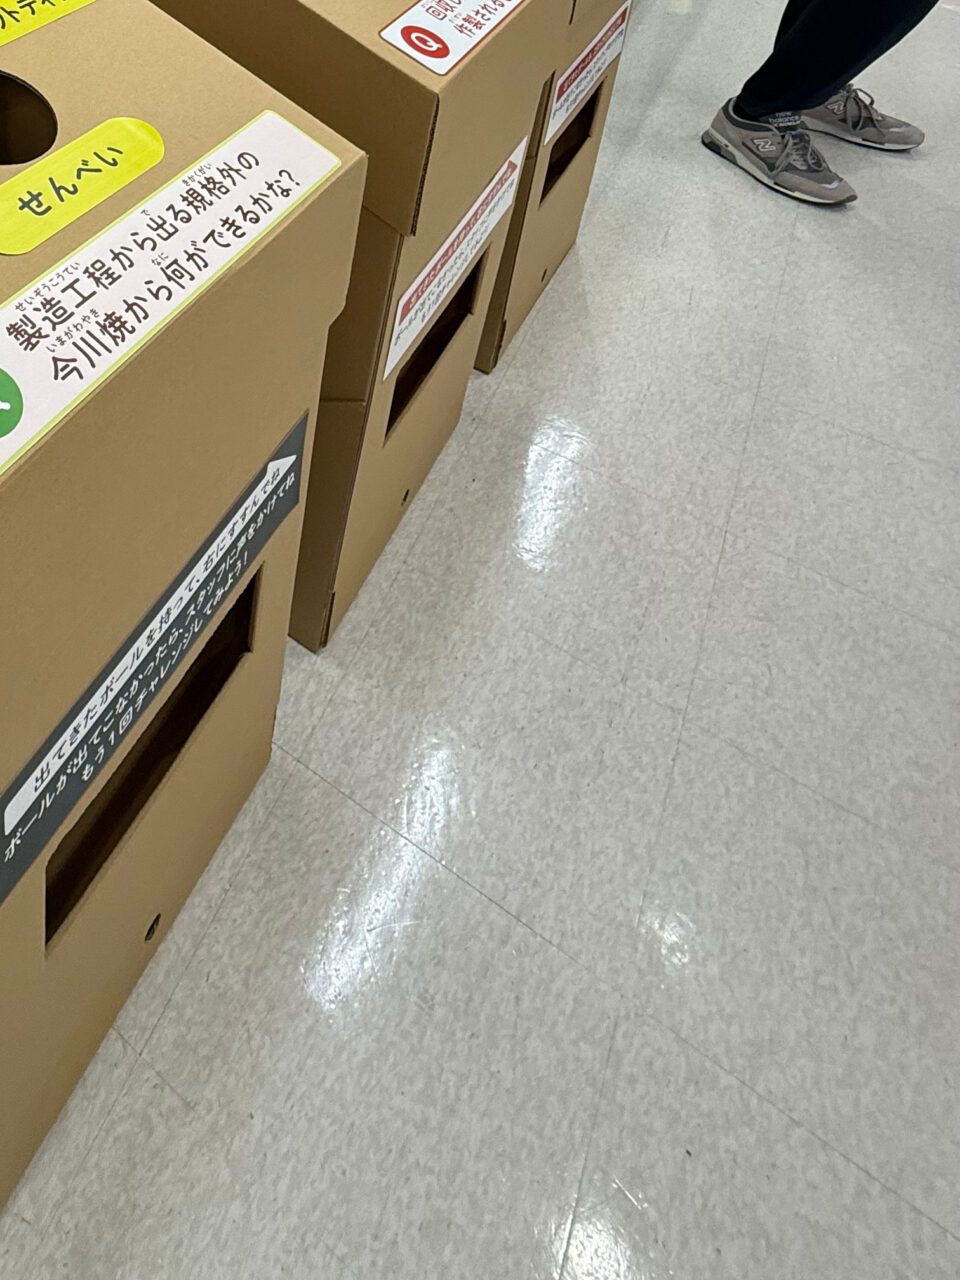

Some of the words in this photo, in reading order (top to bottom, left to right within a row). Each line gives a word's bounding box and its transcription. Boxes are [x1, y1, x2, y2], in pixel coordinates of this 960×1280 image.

[5, 151, 260, 352] 製造工程から出る規格外の
[17, 144, 125, 218] せんべい
[50, 168, 301, 383] 今川焼から何ができるかな?
[3, 471, 297, 864] ボールが出てこなかったら、スタッフに声をかけてね
[34, 466, 282, 793] 出てきたボールを持って、右にすすんでね
